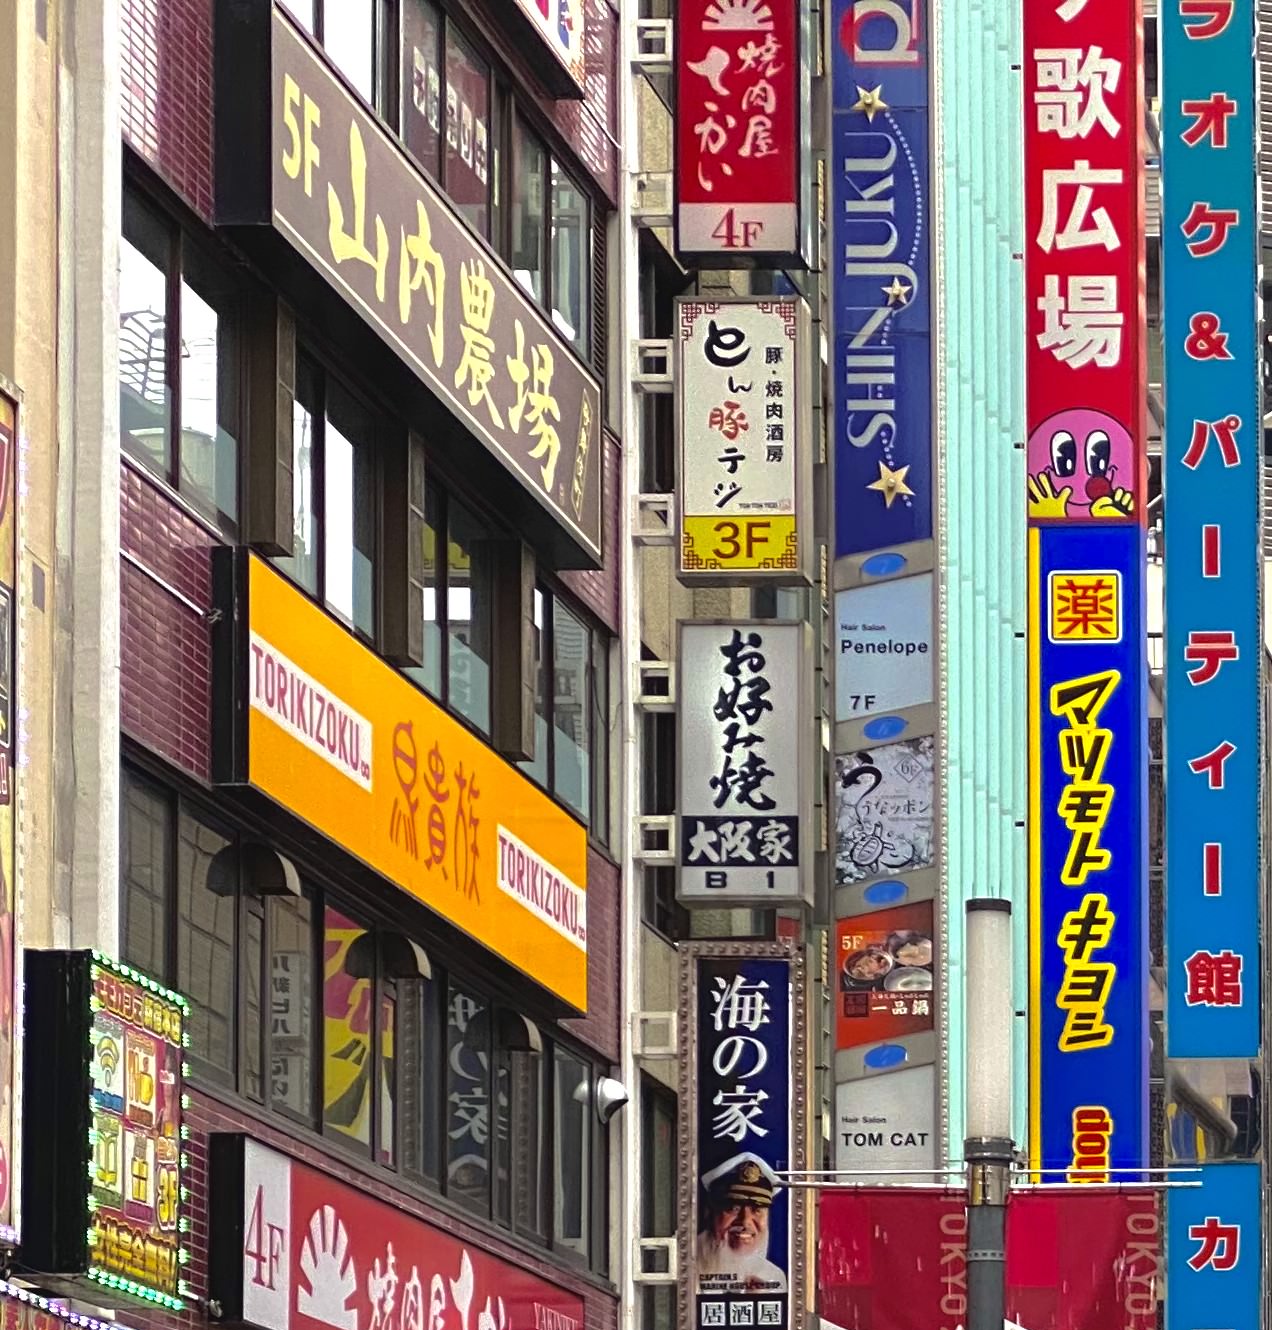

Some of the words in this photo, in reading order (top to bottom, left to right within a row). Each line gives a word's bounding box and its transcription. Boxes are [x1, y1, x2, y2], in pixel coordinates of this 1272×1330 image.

[282, 72, 322, 198] 5F
[735, 34, 783, 160] 焼肉屋
[710, 206, 764, 250] 4F
[1034, 0, 1124, 369] 歌広場
[327, 118, 562, 494] 山内農場
[845, 131, 918, 449] SHINJUKU
[764, 344, 785, 464] 豚・焼肉酒房
[712, 520, 772, 559] 3F
[840, 638, 929, 659] Penelope
[841, 623, 860, 632] Hair
[863, 623, 887, 632] Salon
[1055, 576, 1114, 639] 薬
[250, 643, 361, 777] TORIKIZOKU
[711, 629, 777, 811] お好み焼
[849, 695, 876, 711] 7F
[498, 834, 579, 934] TORIKIZOKU
[686, 817, 794, 865] 大阪家
[1049, 669, 1122, 1053] マツモトキヨシ
[841, 935, 863, 950] 5F
[870, 998, 930, 1017] 一品鍋
[708, 976, 771, 1144] 海の家
[841, 1114, 859, 1125] Hair
[862, 1114, 887, 1125] Salon
[841, 1132, 884, 1147] TOM
[889, 1132, 929, 1147] CAT
[245, 1183, 285, 1291] 4F
[1124, 1191, 1160, 1317] TOKYO
[701, 1301, 782, 1326] 居酒屋
